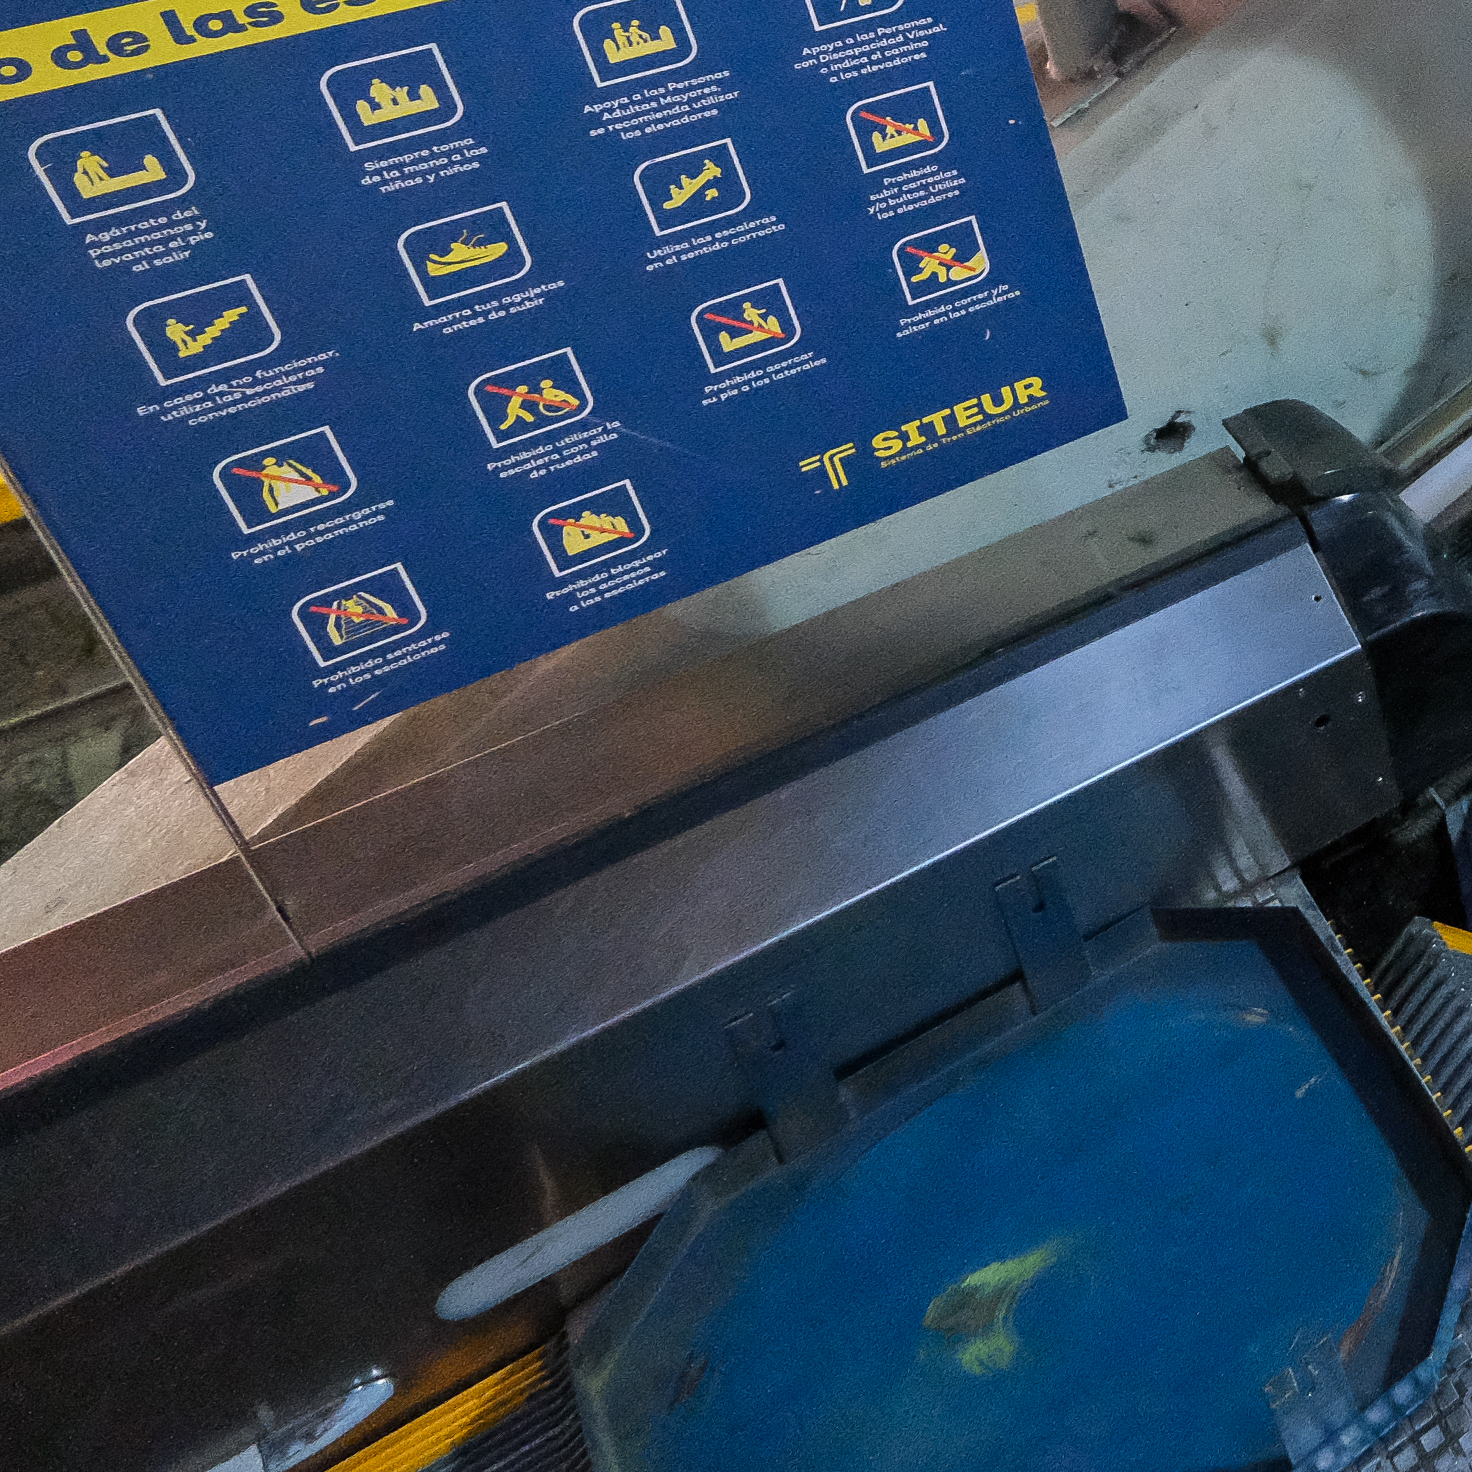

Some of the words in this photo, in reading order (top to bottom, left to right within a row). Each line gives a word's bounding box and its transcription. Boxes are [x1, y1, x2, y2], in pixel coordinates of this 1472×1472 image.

[50, 27, 151, 73] de
[162, 0, 284, 47] las
[794, 59, 818, 70] con
[820, 33, 905, 63] Discapacidad
[802, 40, 844, 56] Apoya
[856, 31, 876, 41] las
[877, 17, 934, 36] Personas
[831, 56, 869, 71] indica
[871, 51, 883, 60] el
[885, 40, 929, 56] camino
[840, 71, 859, 80] los
[861, 51, 928, 75] elevadores
[583, 97, 631, 114] Apoya
[644, 87, 667, 97] las
[668, 70, 731, 91] Personas
[602, 101, 659, 121] Adultas
[589, 127, 606, 137] se
[607, 104, 691, 132] recomienda
[692, 90, 741, 108] utilizar
[621, 129, 643, 140] los
[644, 108, 720, 134] elevadores
[361, 175, 381, 185] de
[383, 169, 400, 179] la
[403, 158, 448, 173] mano
[463, 147, 488, 158] las
[364, 150, 430, 171] Siempre
[432, 138, 475, 153] toma
[379, 176, 423, 194] niñas
[439, 161, 481, 177] niños
[883, 165, 938, 185] Prohibido
[867, 202, 887, 215] y/o
[929, 178, 966, 193] Utiliza
[869, 188, 899, 203] subir
[877, 211, 895, 220] los
[897, 190, 960, 214] elevadores
[86, 217, 168, 244] Agárrate
[172, 206, 201, 219] del
[88, 224, 193, 258] pasamanos
[646, 242, 690, 259] Utiliza
[691, 234, 713, 245] las
[715, 215, 777, 239] escaleras
[94, 246, 167, 268] levanta
[169, 237, 187, 248] el
[189, 232, 214, 245] pie
[132, 261, 151, 272] al
[153, 250, 191, 266] salir
[646, 262, 664, 271] en
[665, 255, 679, 265] el
[680, 241, 730, 261] sentido
[731, 223, 786, 245] correcto
[412, 309, 472, 332] Amarra
[474, 300, 500, 312] tus
[502, 280, 566, 303] agujetas
[442, 317, 486, 334] antes
[488, 310, 506, 320] de
[509, 297, 545, 314] subir
[895, 321, 932, 338] saltar
[933, 315, 948, 325] en
[949, 308, 967, 319] las
[968, 290, 1022, 312] escaleras
[899, 304, 953, 326] Prohibido
[954, 290, 990, 307] correr
[991, 284, 1010, 298] y/o
[702, 396, 719, 407] su
[720, 388, 739, 402] pie
[752, 377, 771, 388] los
[771, 357, 828, 381] laterales
[704, 369, 764, 394] Prohibido
[766, 351, 814, 372] acercar
[137, 404, 160, 417] En
[163, 391, 204, 408] caso
[207, 383, 229, 395] de
[230, 376, 253, 388] no
[160, 401, 214, 421] utiliza
[216, 392, 243, 405] las
[245, 366, 325, 395] escaleras
[188, 381, 316, 426] convencionales
[872, 376, 1047, 458] SITEUR
[487, 445, 554, 471] Prohibido
[555, 426, 605, 447] utilizar
[605, 420, 622, 431] la
[500, 453, 561, 478] escalera
[563, 443, 589, 456] con
[591, 432, 619, 446] silla
[530, 469, 548, 479] de
[549, 450, 599, 472] ruedas
[231, 530, 306, 560] Prohibido
[310, 499, 394, 533] recargarse
[254, 554, 274, 564] en
[277, 546, 292, 556] el
[294, 514, 386, 552] pasamanos
[546, 572, 609, 600] Prohibido
[610, 549, 669, 574] bloquear
[576, 587, 598, 599] los
[599, 566, 652, 590] accesos
[580, 596, 602, 608] las
[603, 570, 667, 598] escaleras
[312, 657, 383, 688] Prohibido
[386, 631, 450, 660] sentarse
[328, 683, 347, 693] en
[349, 673, 372, 685] los
[374, 644, 447, 675] escalones
